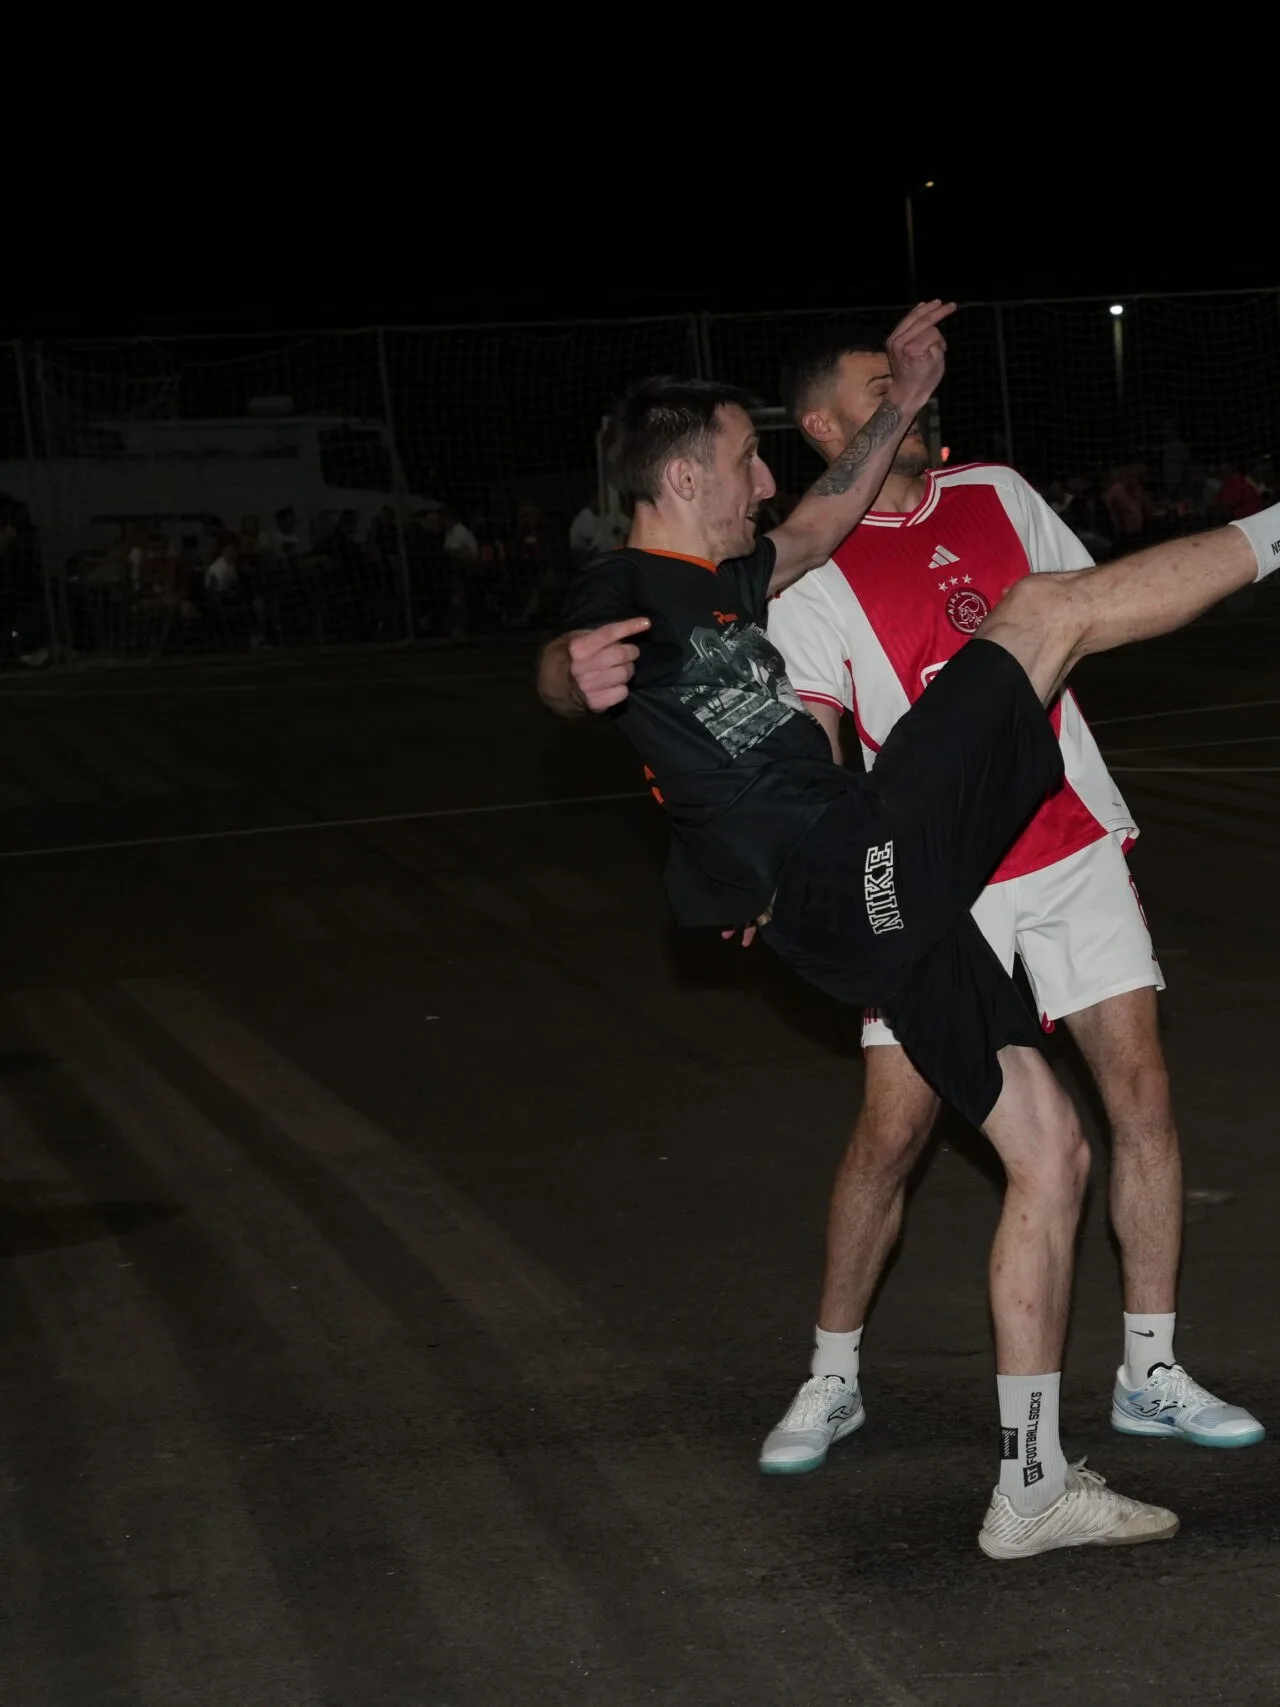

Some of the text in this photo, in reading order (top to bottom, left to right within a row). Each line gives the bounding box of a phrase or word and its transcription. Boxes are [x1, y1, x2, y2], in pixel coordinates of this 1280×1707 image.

[948, 592, 962, 615] AJAX
[864, 840, 904, 935] NIKE
[1029, 1391, 1042, 1420] SOCKS
[1026, 1421, 1039, 1465] FOOTBALL
